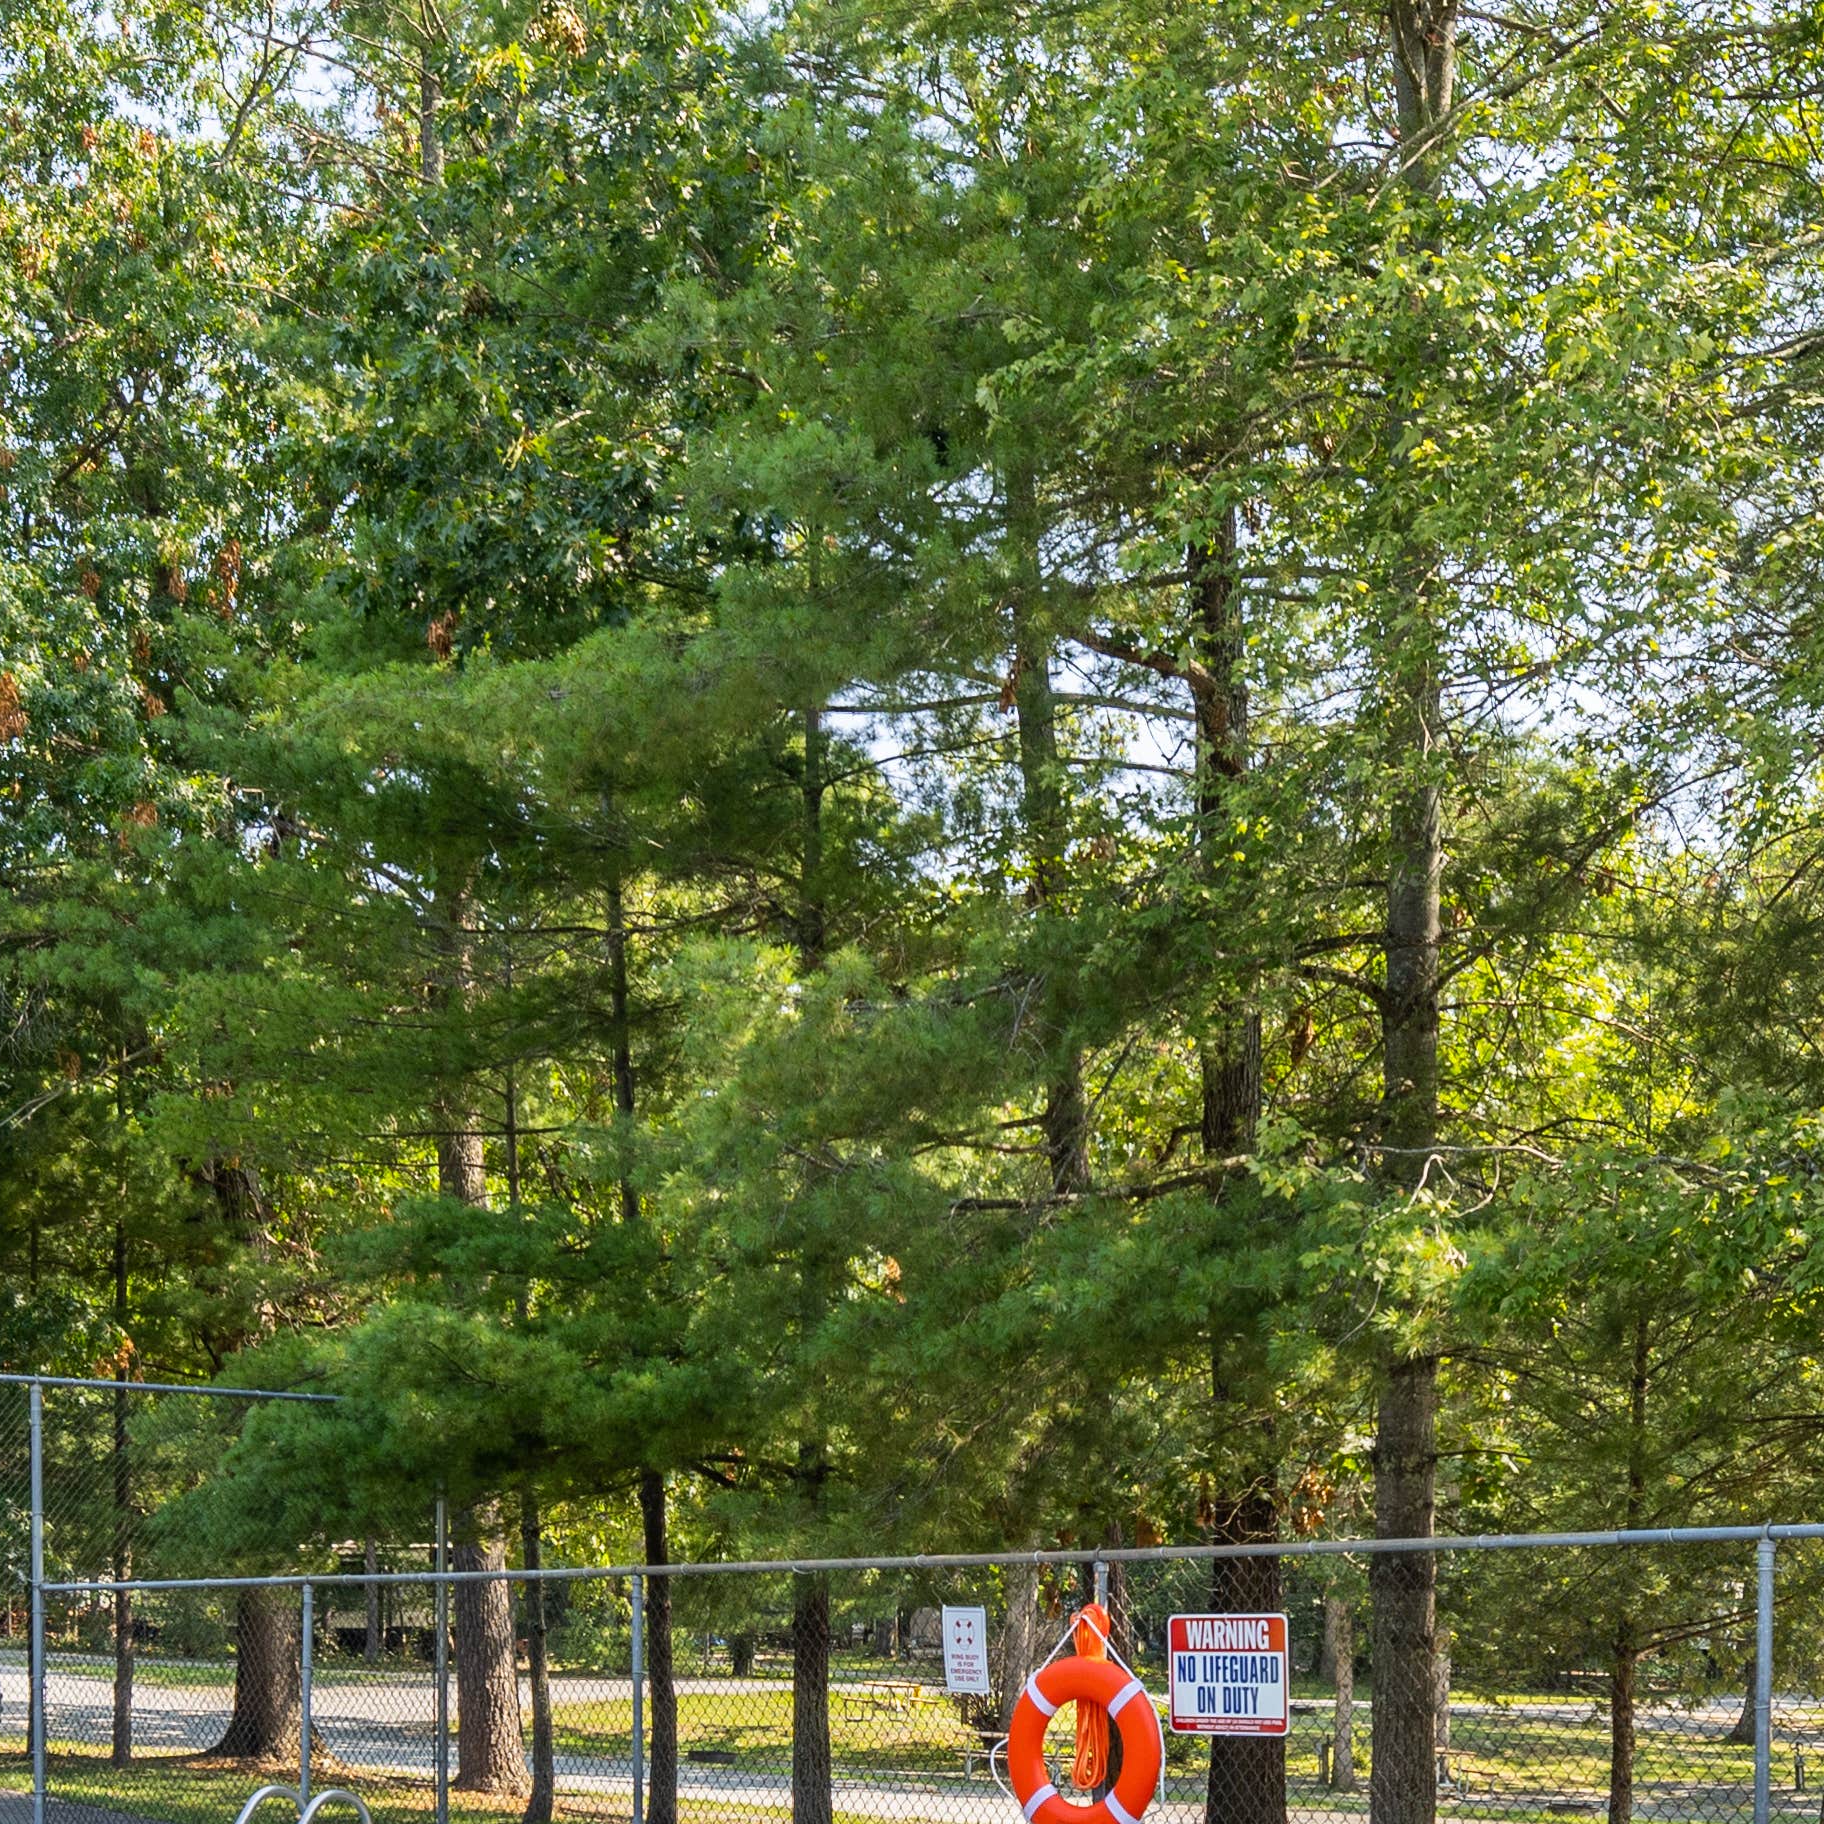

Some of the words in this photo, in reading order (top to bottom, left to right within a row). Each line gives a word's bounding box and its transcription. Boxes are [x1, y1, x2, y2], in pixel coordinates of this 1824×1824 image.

[1185, 1619, 1270, 1650] WARNING
[1177, 1655, 1196, 1683] NO
[1203, 1655, 1279, 1684] LIFEGUARD
[1197, 1686, 1216, 1713] ON
[1223, 1686, 1259, 1715] DUTY
